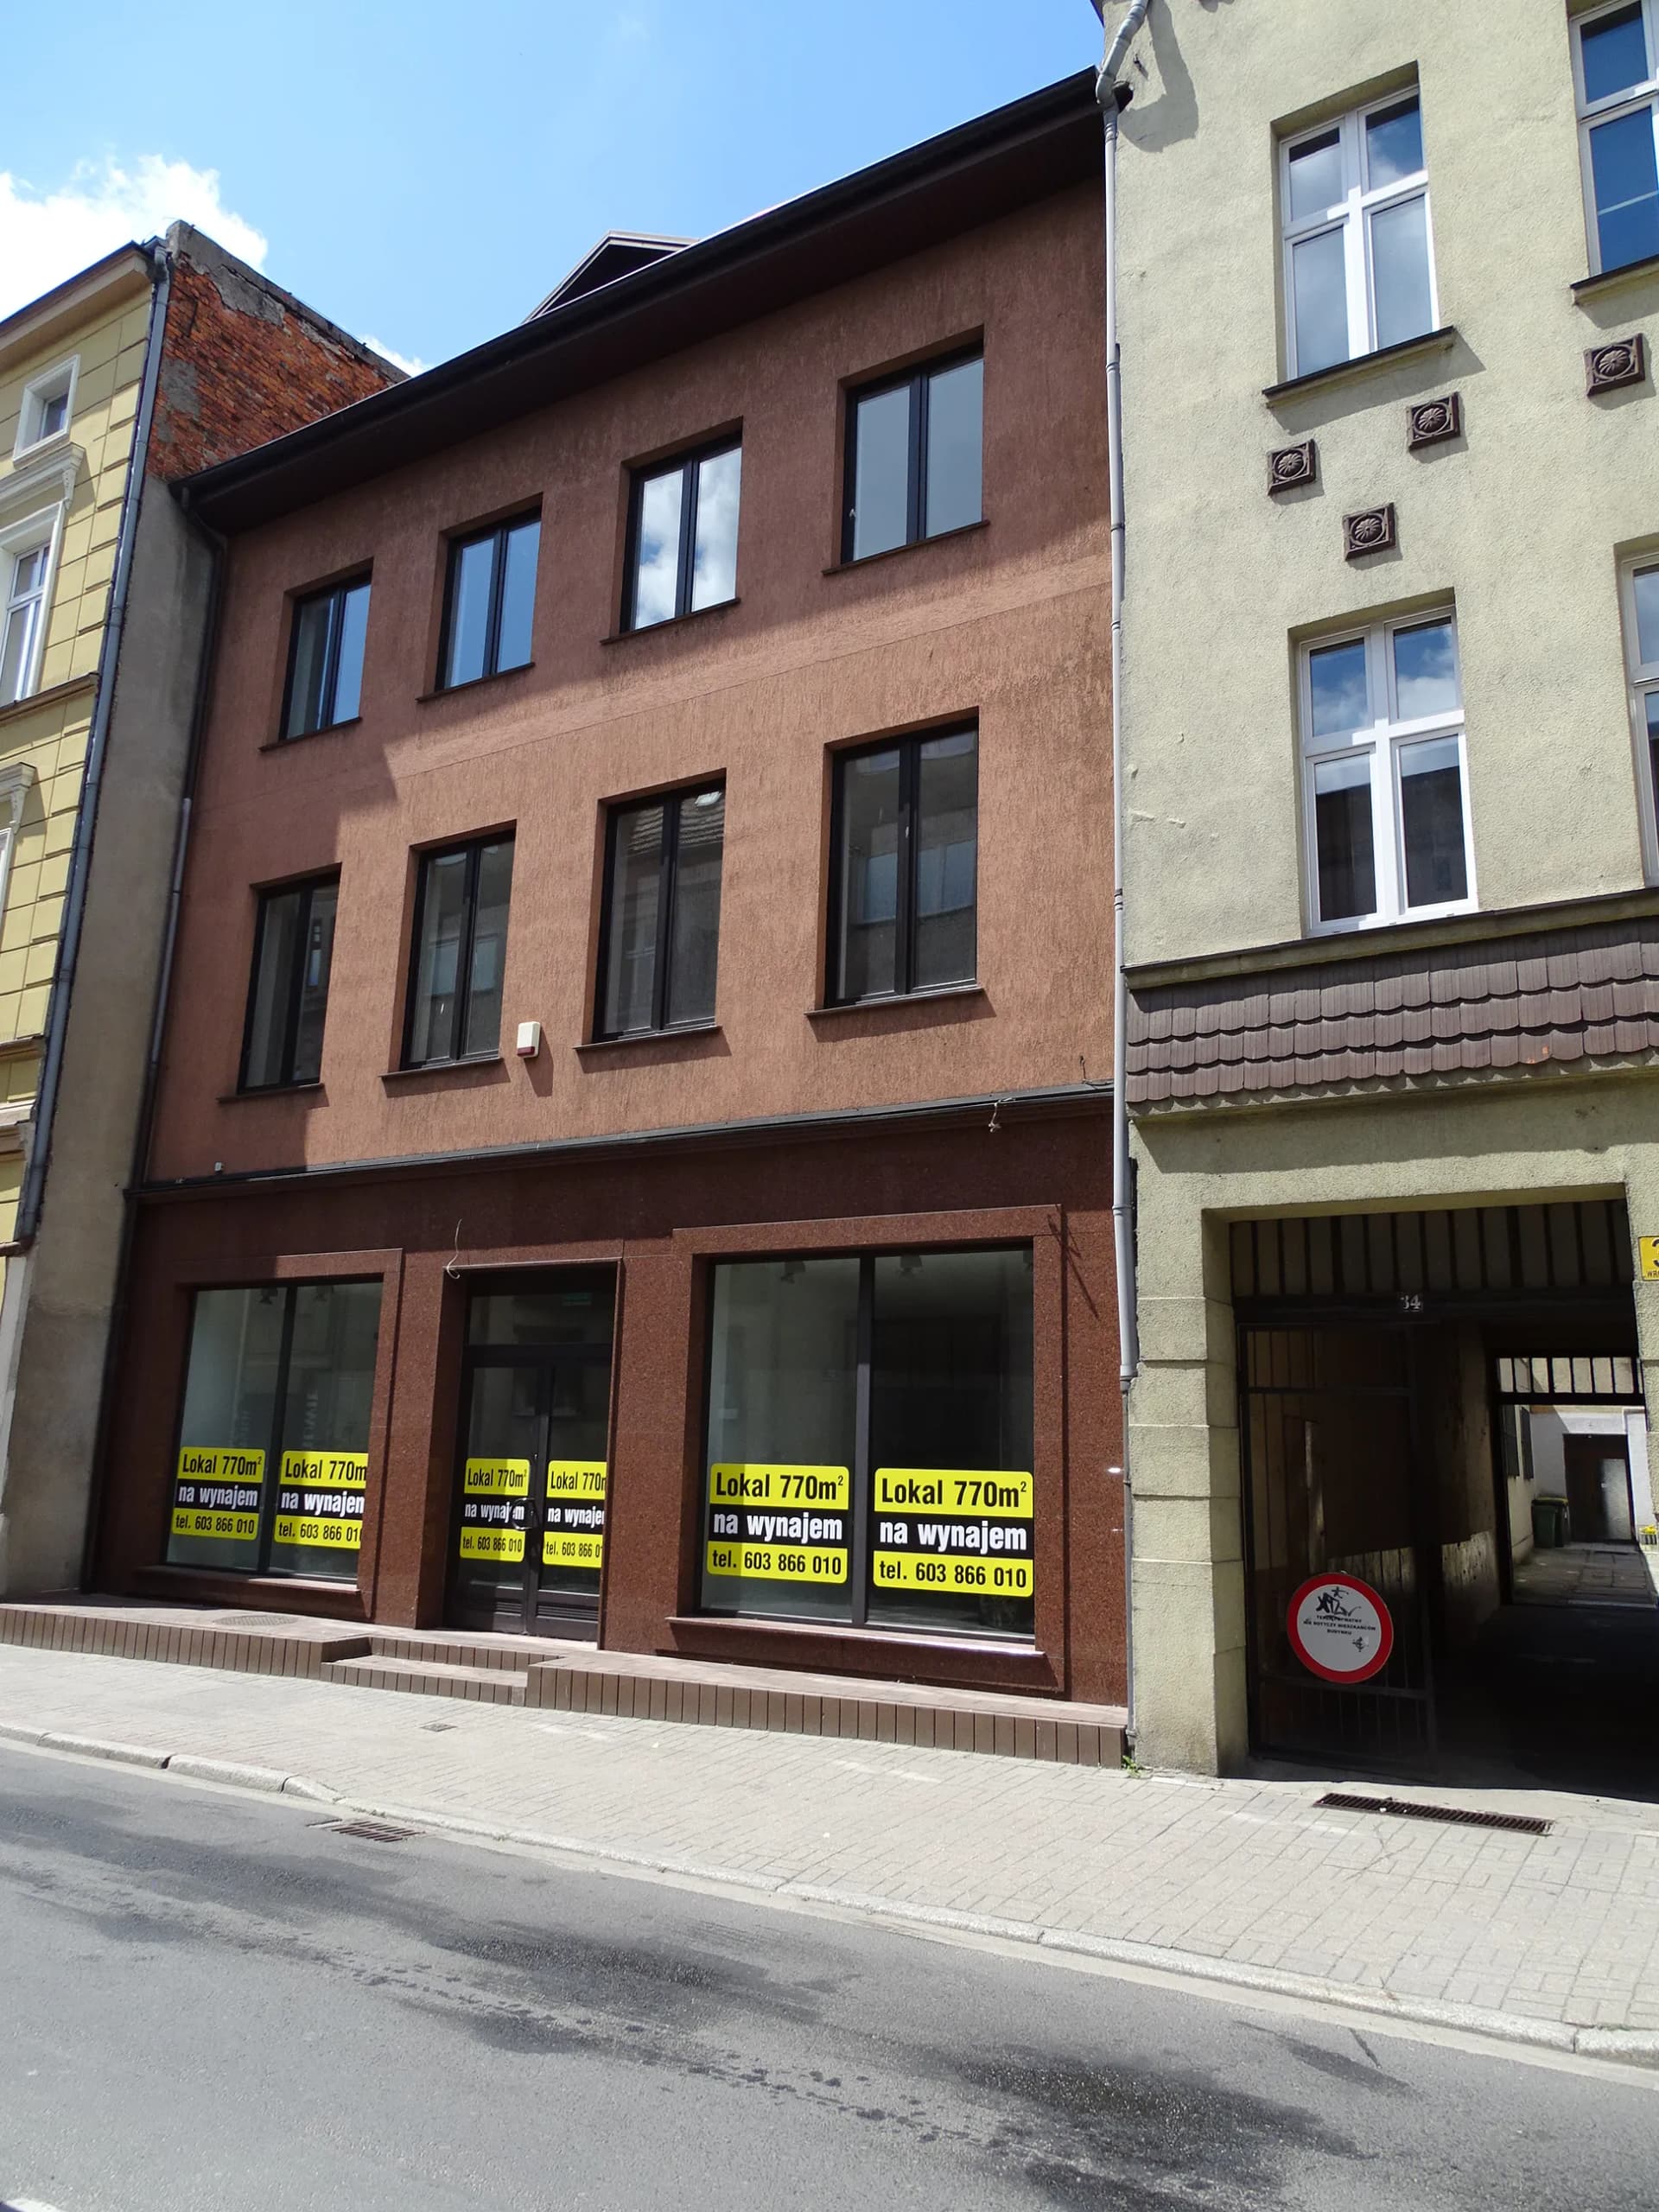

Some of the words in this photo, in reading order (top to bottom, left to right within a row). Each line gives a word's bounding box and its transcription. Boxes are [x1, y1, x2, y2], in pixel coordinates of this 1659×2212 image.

[182, 1454, 217, 1474] Lokal
[285, 1458, 322, 1479] Lokal
[329, 1460, 367, 1481] 770m
[467, 1468, 493, 1486] Lokal
[550, 1471, 578, 1490] Lokal
[582, 1472, 606, 1491] 770
[716, 1471, 770, 1497] Lokal
[779, 1475, 843, 1500] 770m²
[178, 1485, 194, 1503] na
[200, 1484, 258, 1510] wynajem
[281, 1491, 298, 1510] na
[882, 1478, 943, 1504] Lokal
[954, 1480, 1027, 1508] 770m²
[464, 1503, 476, 1517] na
[547, 1507, 561, 1522] na
[564, 1505, 605, 1529] wynaje
[175, 1515, 191, 1529] tel.
[194, 1516, 213, 1530] 603
[216, 1517, 232, 1532] 866
[236, 1519, 255, 1535] 010
[278, 1522, 296, 1537] tel.
[300, 1524, 319, 1539] 603
[323, 1526, 342, 1541] 866
[346, 1527, 362, 1542] 01
[714, 1513, 738, 1534] na
[747, 1512, 842, 1544] wynajem
[462, 1536, 474, 1549] tel.
[477, 1537, 490, 1551] 603
[493, 1538, 506, 1552] 866
[508, 1539, 522, 1553] 010
[880, 1521, 908, 1544] na
[917, 1520, 1027, 1554] wynajem
[545, 1541, 559, 1554] tel.
[562, 1542, 575, 1556] 603
[578, 1543, 593, 1557] 866
[712, 1549, 737, 1568] tel.
[744, 1551, 771, 1570] 603
[778, 1554, 805, 1573] 866
[812, 1555, 842, 1574] 010
[880, 1560, 907, 1580] tel.
[916, 1562, 946, 1583] 603
[954, 1564, 986, 1585] 866
[994, 1567, 1027, 1588] 010
